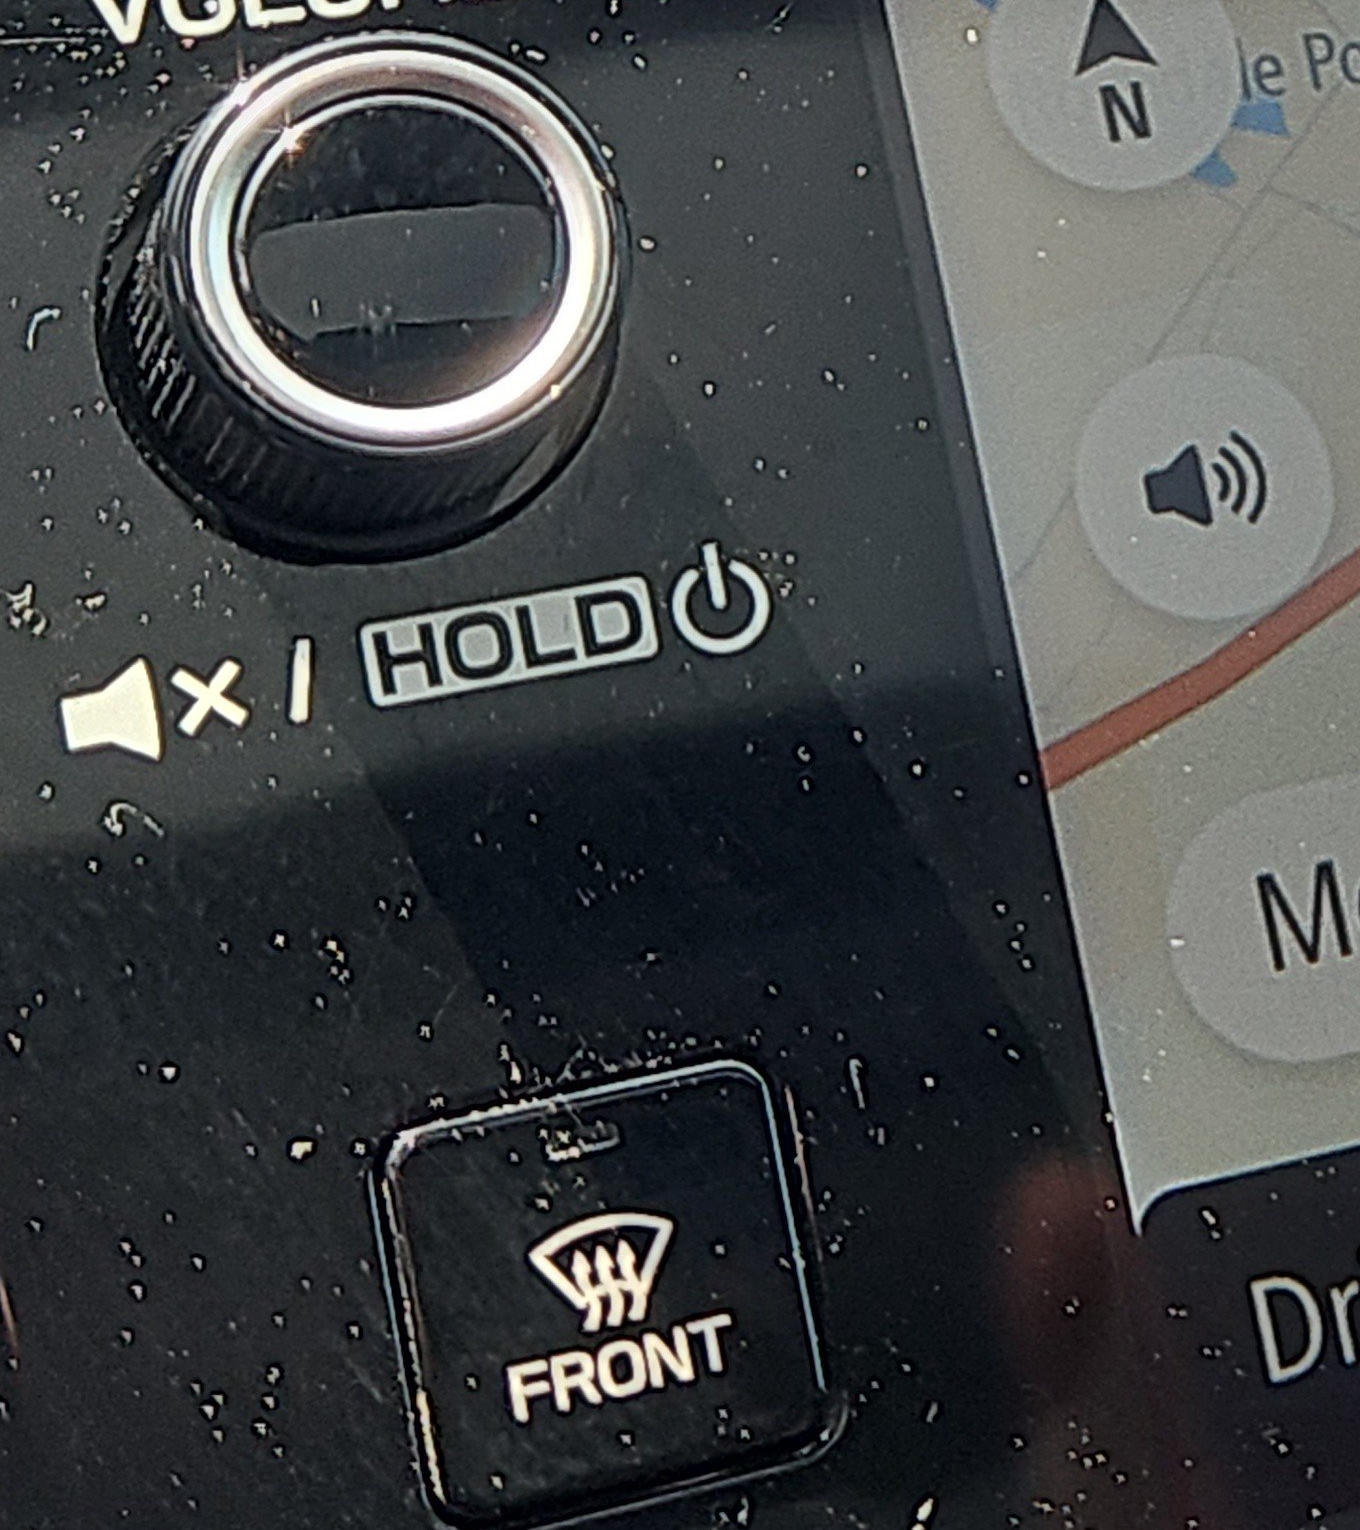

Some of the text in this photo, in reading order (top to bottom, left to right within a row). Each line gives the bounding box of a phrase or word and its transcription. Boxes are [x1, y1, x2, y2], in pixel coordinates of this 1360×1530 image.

[1101, 80, 1152, 144] N
[372, 588, 646, 699] HOLD
[505, 1313, 734, 1424] FRONT
